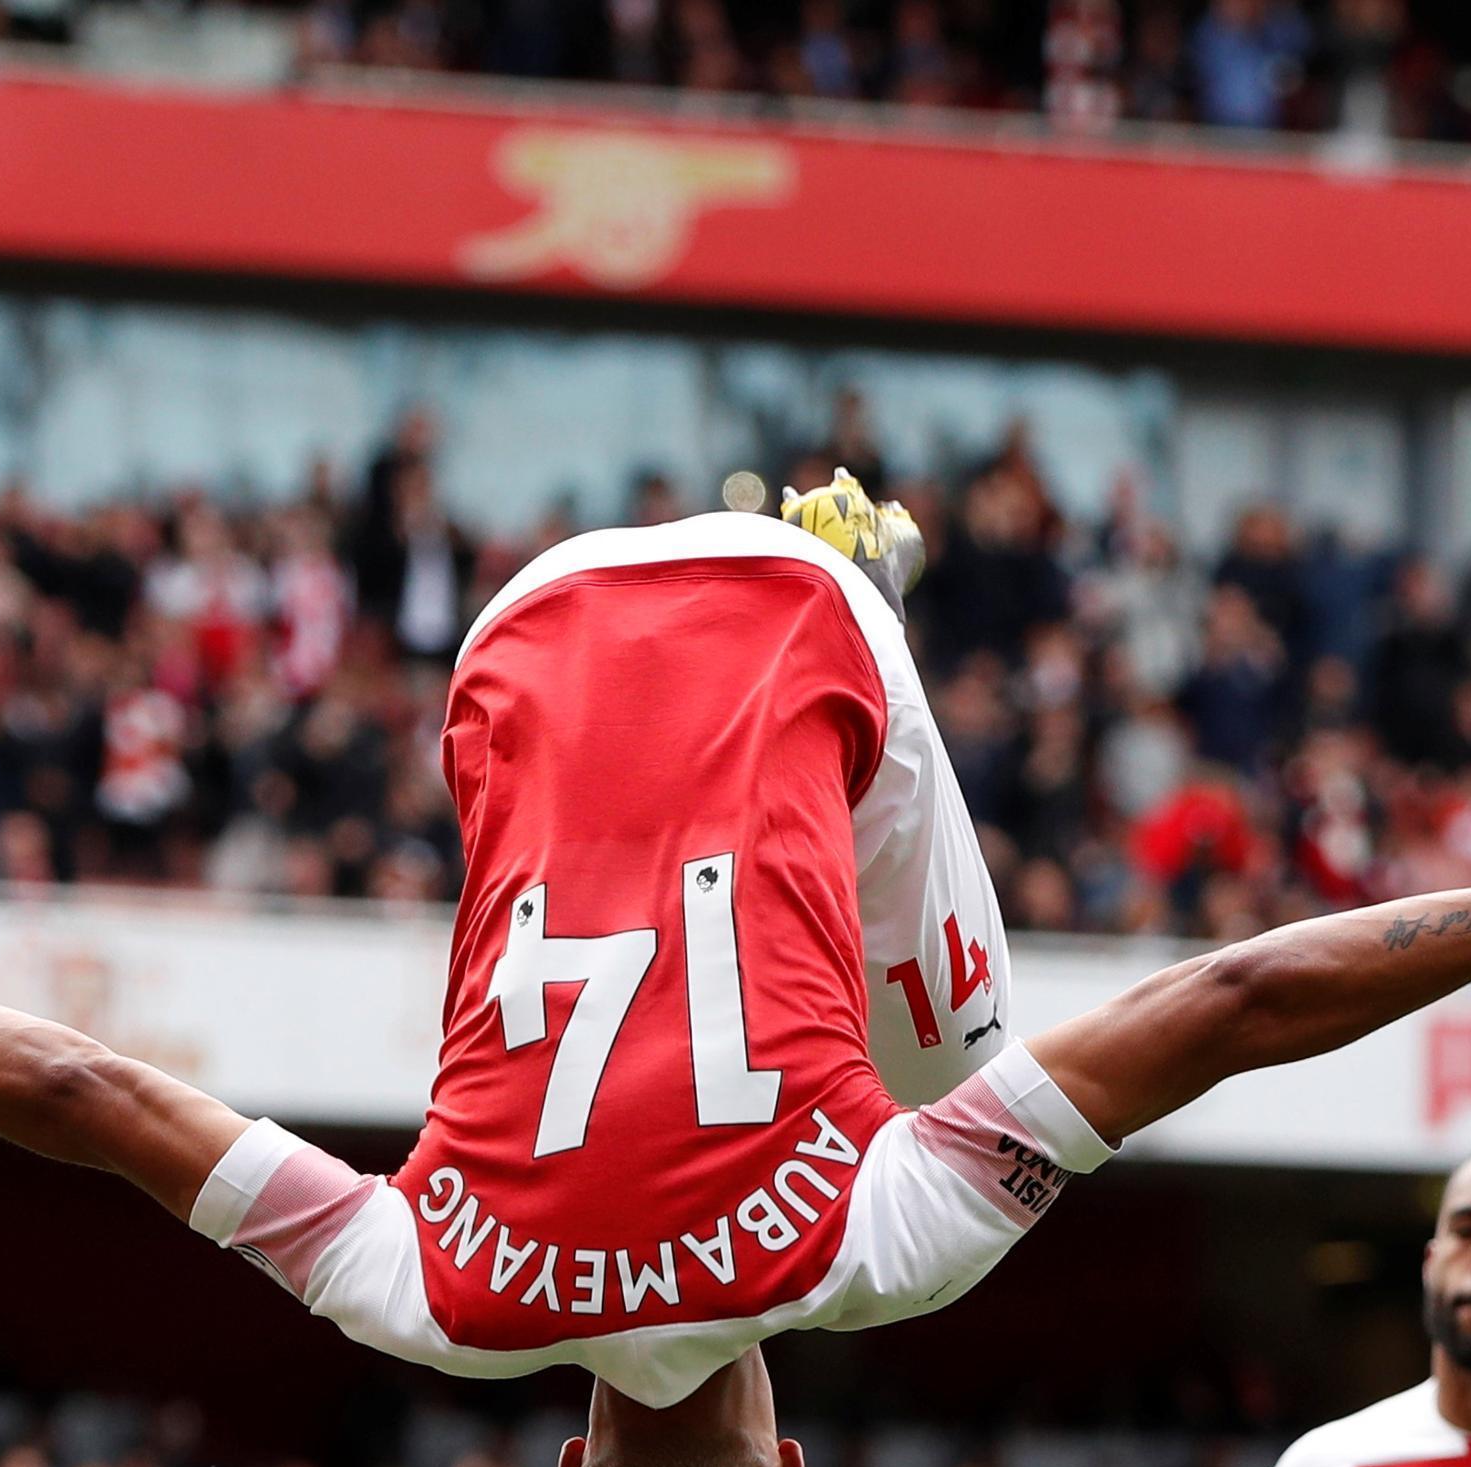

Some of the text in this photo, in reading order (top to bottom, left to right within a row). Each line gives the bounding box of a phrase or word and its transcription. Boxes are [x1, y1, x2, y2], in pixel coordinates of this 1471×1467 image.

[484, 851, 783, 1160] 14
[885, 910, 992, 1050] 14
[417, 1107, 861, 1315] AUBAMEYANG
